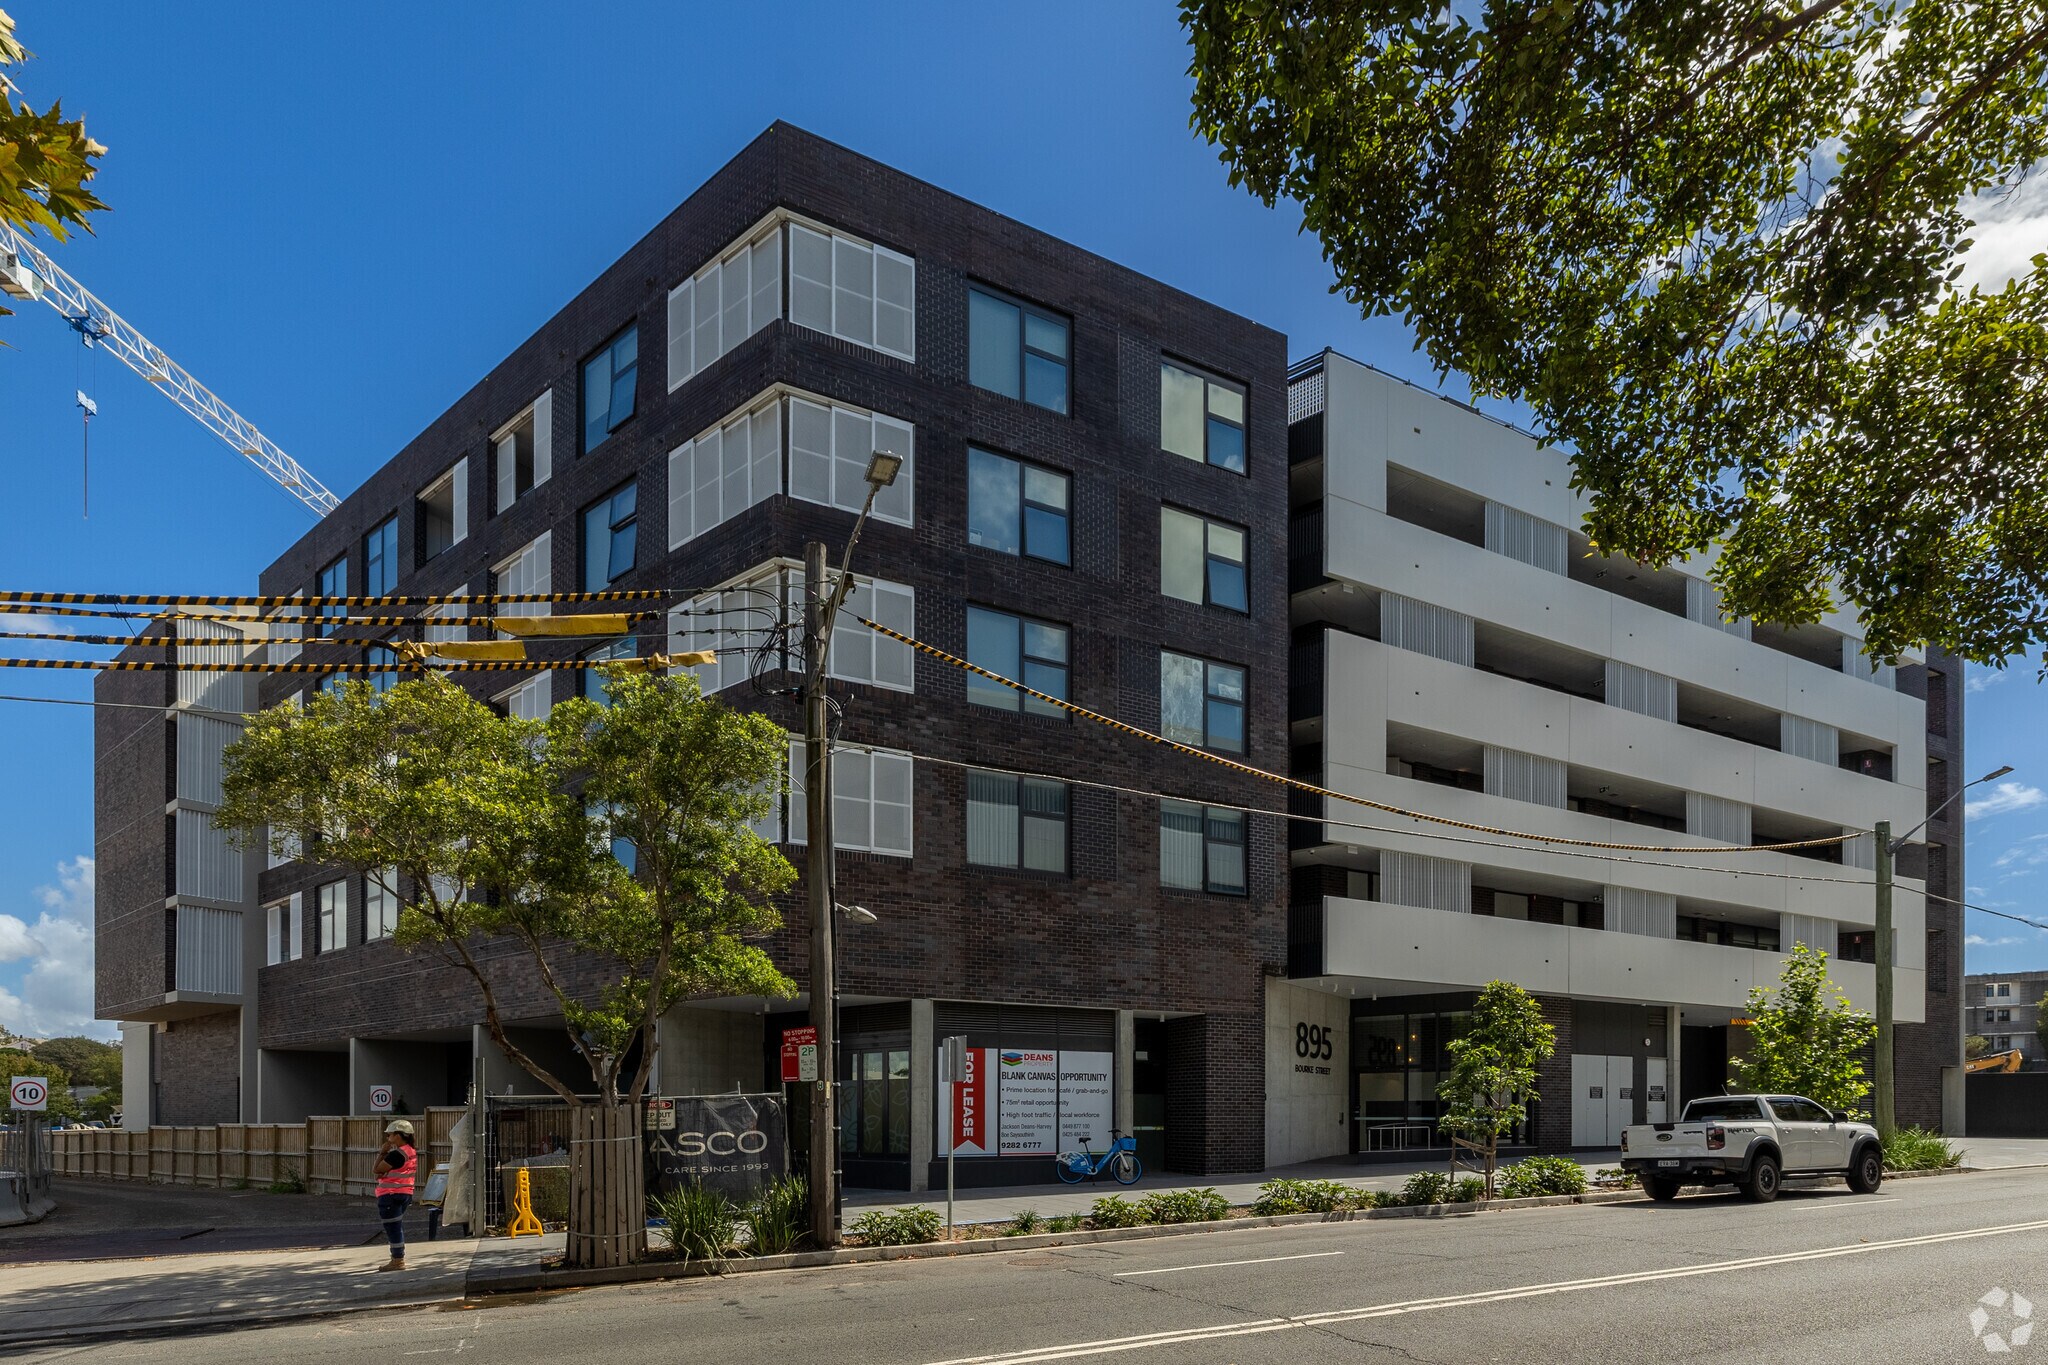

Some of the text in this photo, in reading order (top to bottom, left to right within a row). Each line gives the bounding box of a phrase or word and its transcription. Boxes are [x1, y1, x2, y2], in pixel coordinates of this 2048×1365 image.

[1296, 1022, 1332, 1060] 895
[802, 1046, 815, 1056] 2P
[1024, 1053, 1054, 1062] DEANS
[1295, 1064, 1331, 1076] BOURKE STREET
[1001, 1071, 1108, 1082] BLANK CANVAS OPPORTUNITY
[19, 1087, 39, 1100] 10
[375, 1093, 388, 1103] 10
[963, 1052, 974, 1137] FOR LEASE
[1727, 1127, 1759, 1136] RAPTOR
[649, 1130, 768, 1156] ASCO
[1022, 1141, 1042, 1149] 6777
[665, 1162, 769, 1174] CARE SINCE 1993
